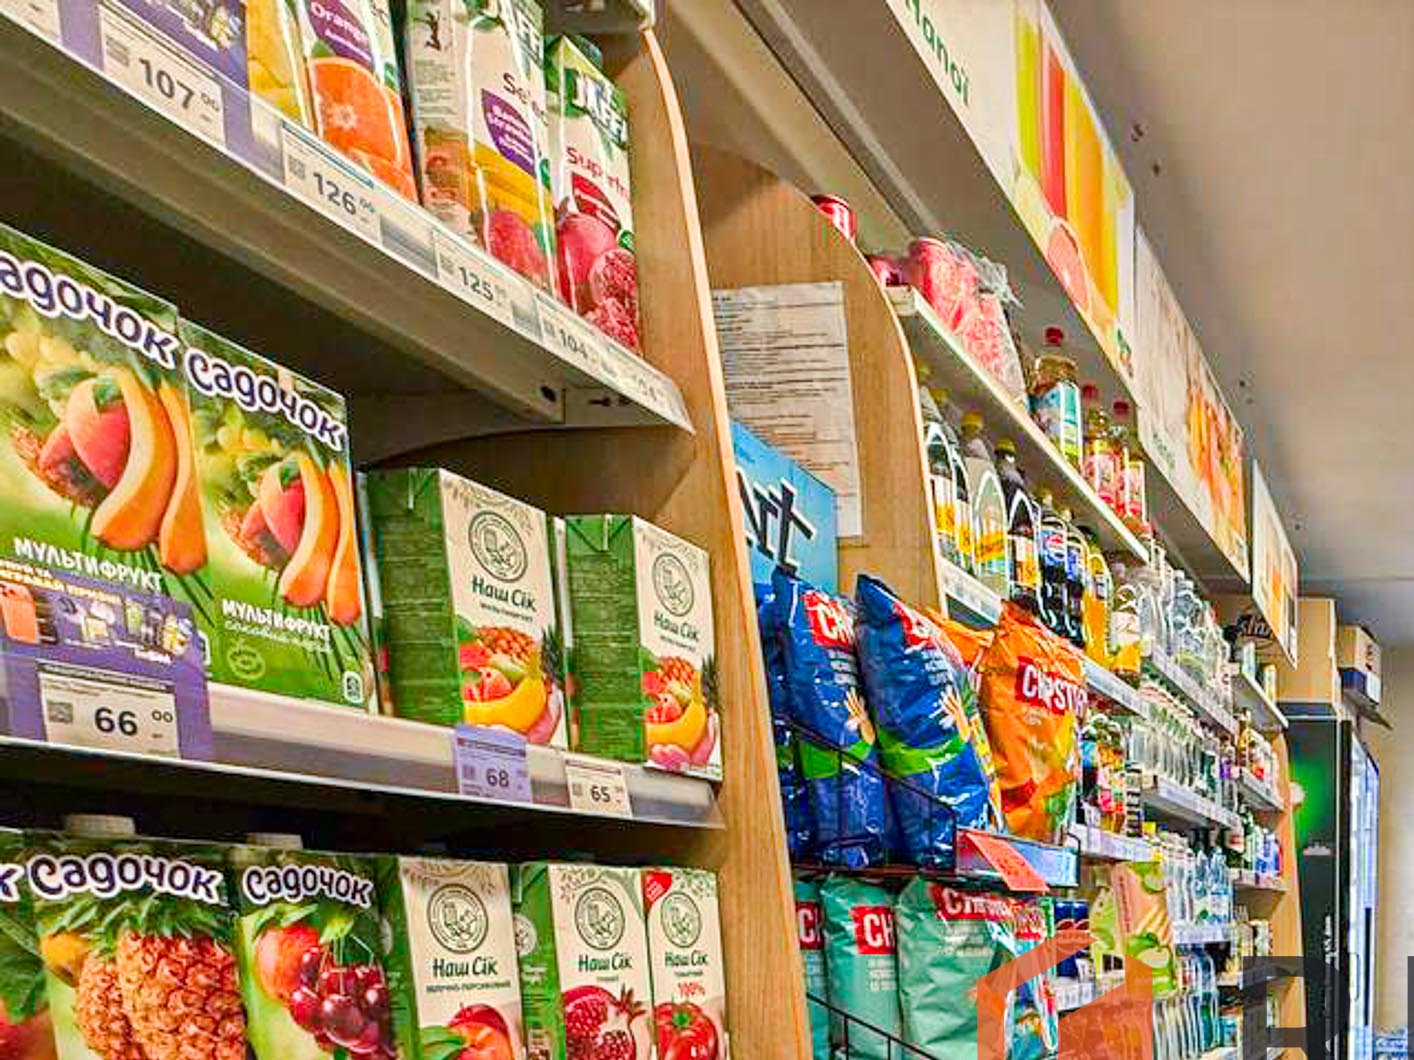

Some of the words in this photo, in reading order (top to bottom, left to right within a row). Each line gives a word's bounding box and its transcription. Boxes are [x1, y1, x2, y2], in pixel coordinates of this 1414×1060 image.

[139, 58, 194, 110] 107
[314, 172, 357, 216] 126
[459, 265, 493, 302] 125
[14, 538, 162, 591] МУЛЬТИФРУКТ
[471, 575, 509, 603] Наш
[511, 588, 538, 613] Сік
[223, 600, 331, 641] МУЛЬТИФРУКТ
[94, 708, 138, 736] 66
[486, 765, 509, 788] 68
[591, 786, 611, 802] 65
[30, 857, 222, 902] Садочок
[247, 867, 372, 906] Садочок
[432, 958, 469, 978] Наш
[472, 955, 498, 976] Сік
[578, 954, 611, 973] Наш
